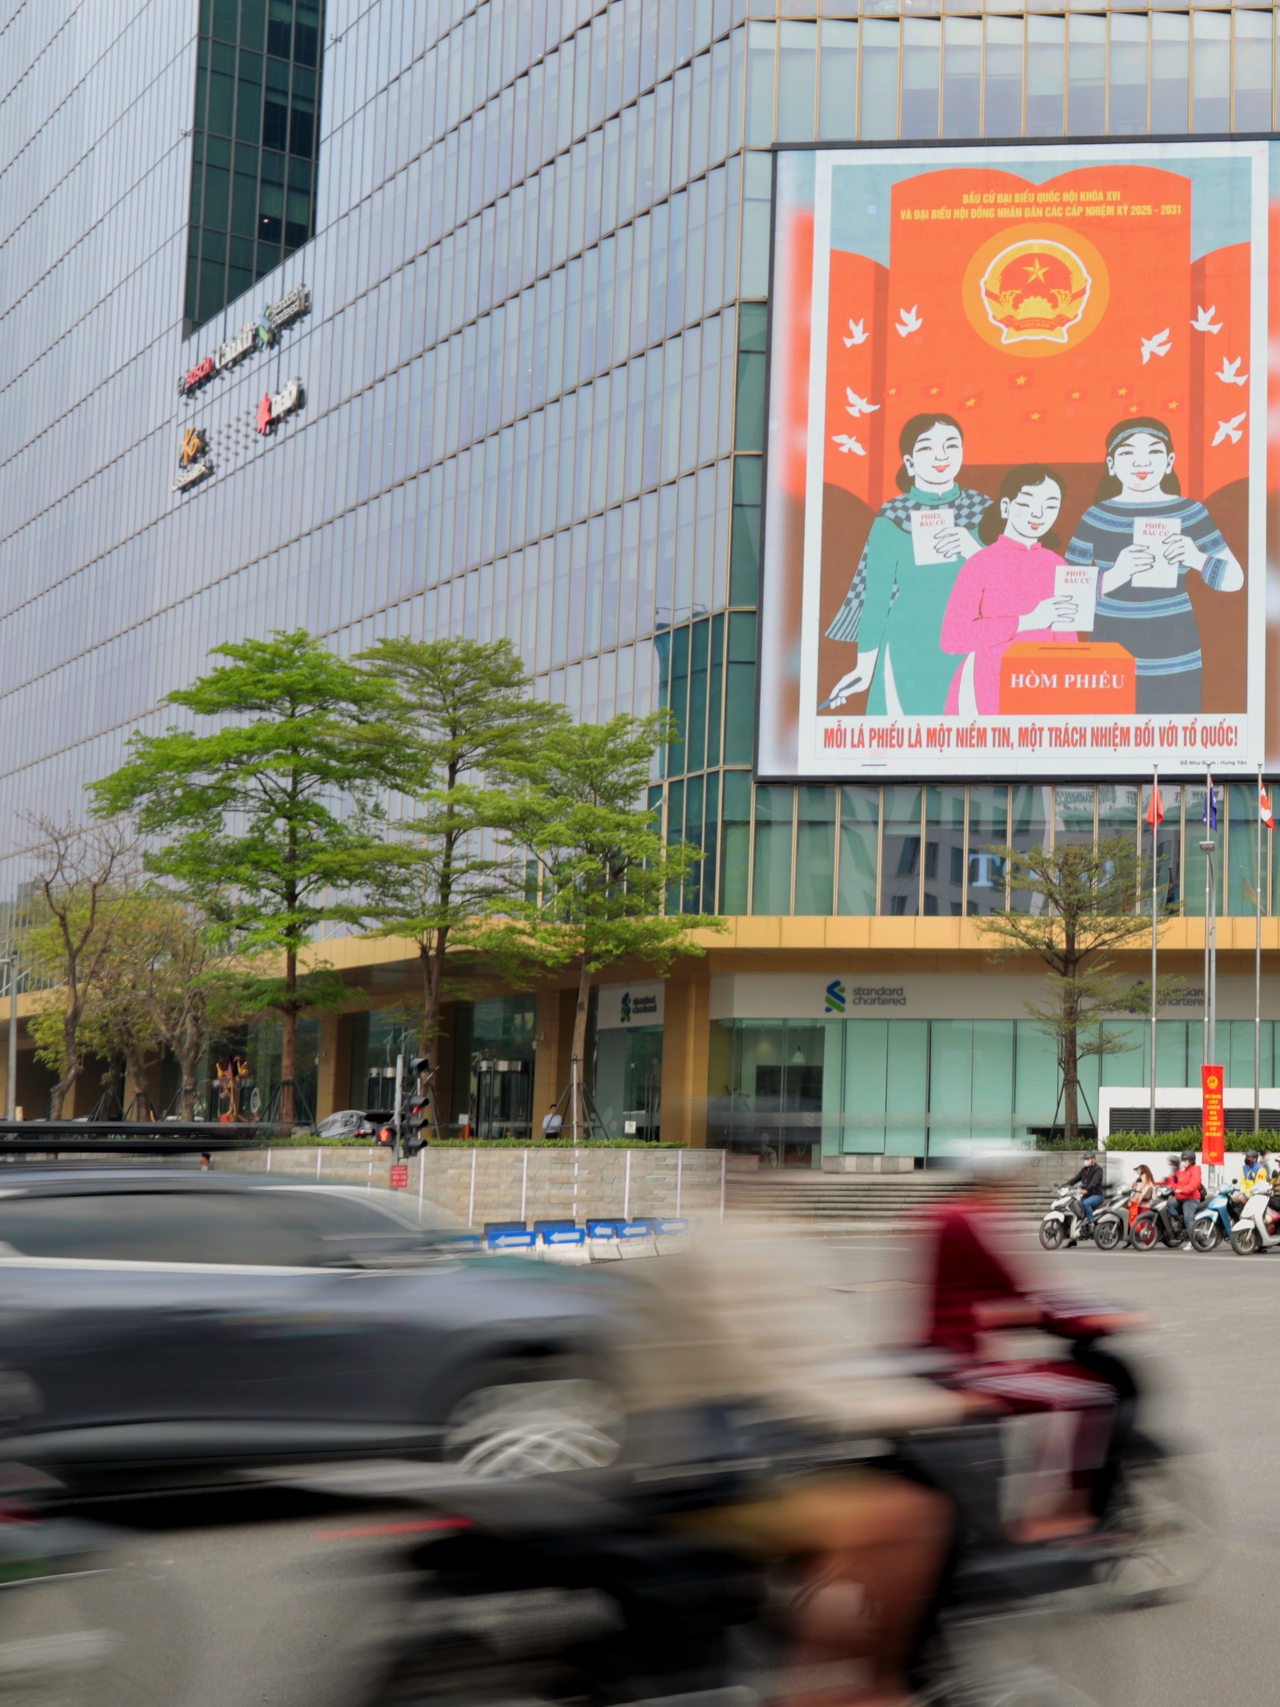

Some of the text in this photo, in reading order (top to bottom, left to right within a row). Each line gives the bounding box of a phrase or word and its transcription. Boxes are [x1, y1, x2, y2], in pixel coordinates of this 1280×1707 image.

[1106, 191, 1121, 201] XVI
[1130, 205, 1152, 215] 2026
[1160, 204, 1182, 215] 2031
[1010, 669, 1125, 689] HÒM PHIẾU
[823, 718, 1238, 753] MỖI LÁ PHIẾU LÀ MỘT NIỀM TIN, MỘT TRÁCH NHIỆM ĐỐI VỚI TỔ QUỐC!
[852, 986, 904, 996] standard
[852, 995, 907, 1006] chartered
